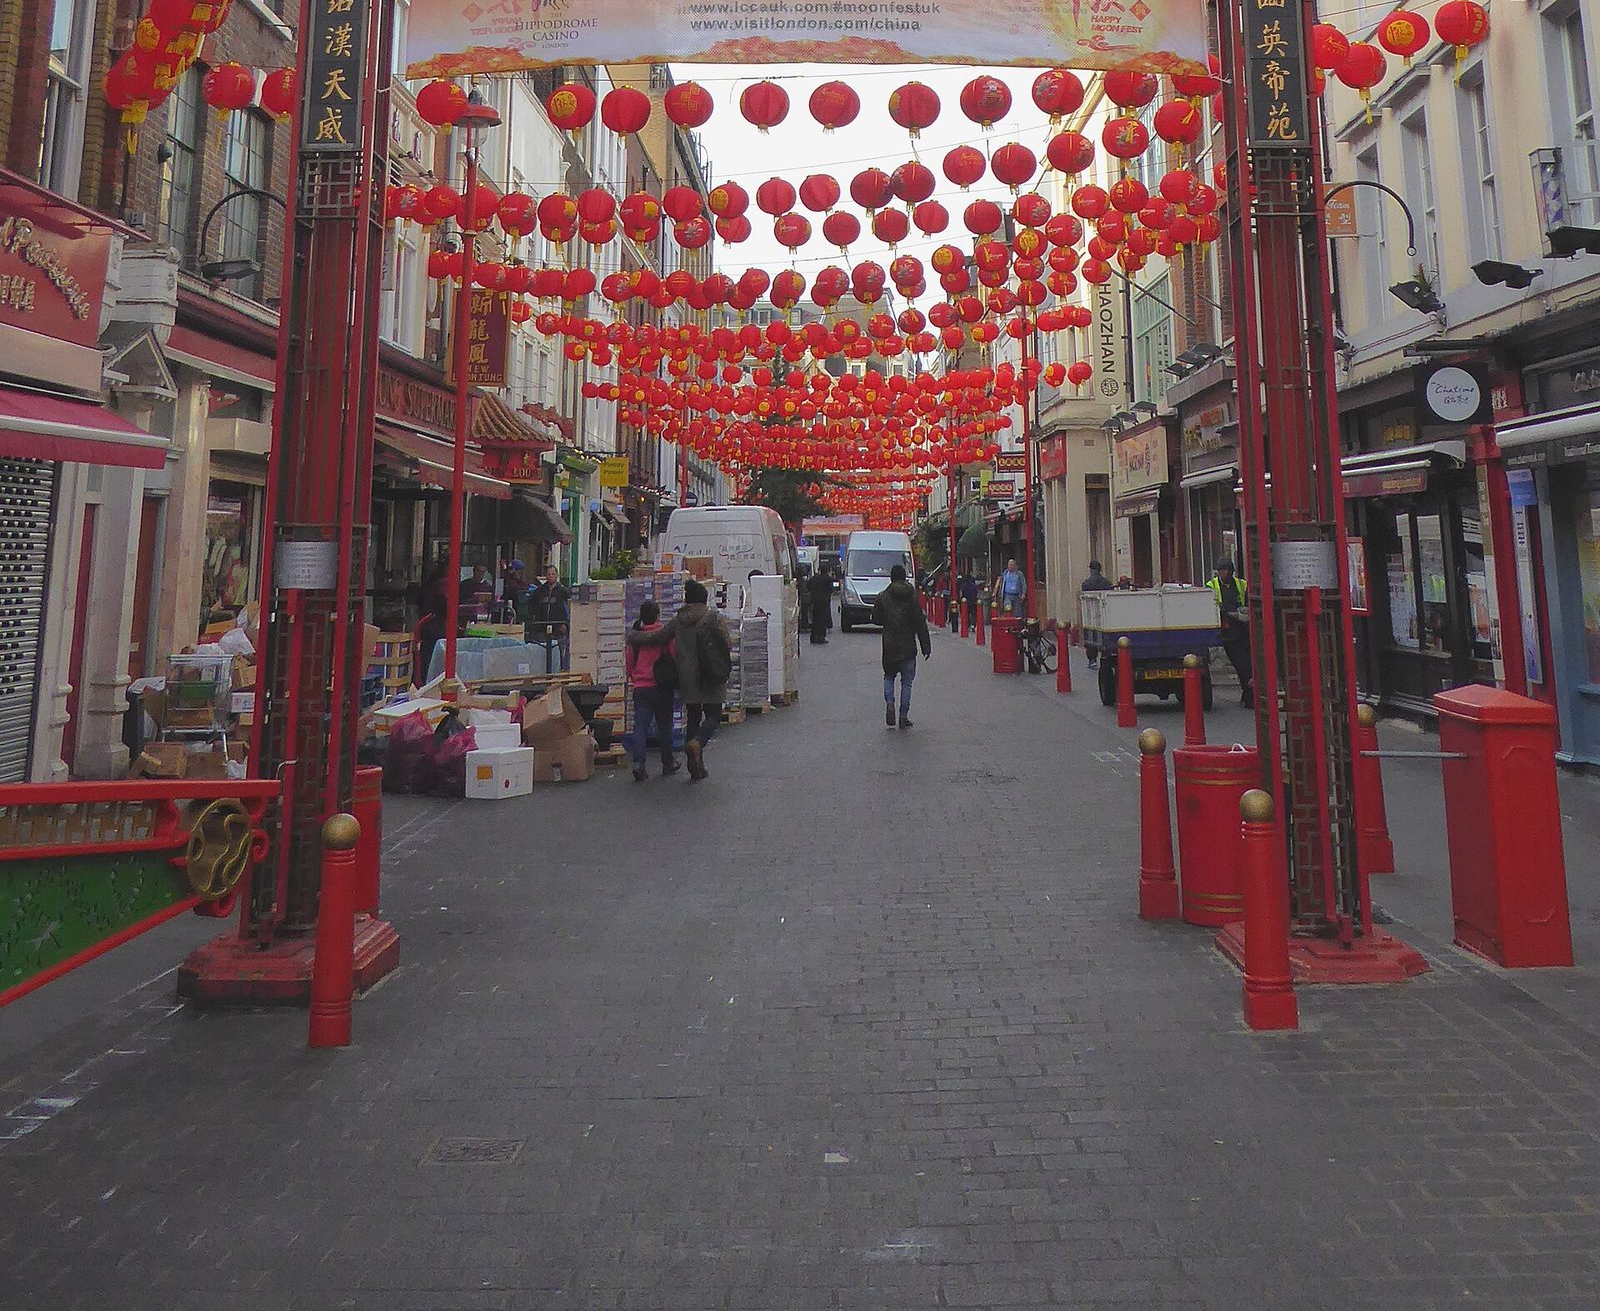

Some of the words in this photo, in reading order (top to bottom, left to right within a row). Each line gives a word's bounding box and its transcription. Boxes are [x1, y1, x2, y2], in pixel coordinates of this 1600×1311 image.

[515, 18, 598, 31] HIPPODROME
[690, 16, 921, 31] www.visitlondon.com/china
[532, 30, 579, 42] CASINO
[1098, 283, 1116, 373] HAOZHAN
[406, 382, 458, 431] SUPERMARK
